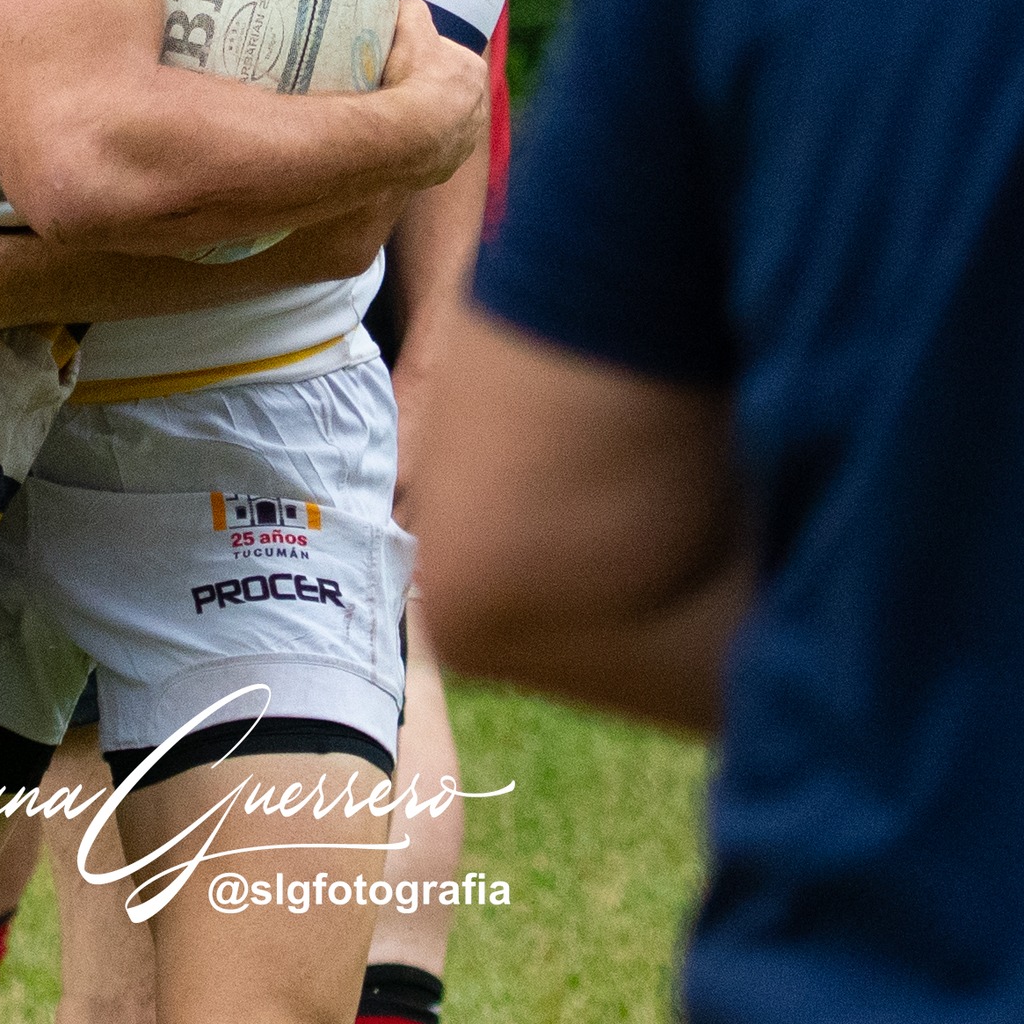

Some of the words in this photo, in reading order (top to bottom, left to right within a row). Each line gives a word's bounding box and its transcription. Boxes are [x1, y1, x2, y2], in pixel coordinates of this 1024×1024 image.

[230, 531, 255, 548] 25
[259, 529, 308, 547] años
[232, 547, 310, 560] TUCUMÁN
[191, 573, 346, 615] PROCER
